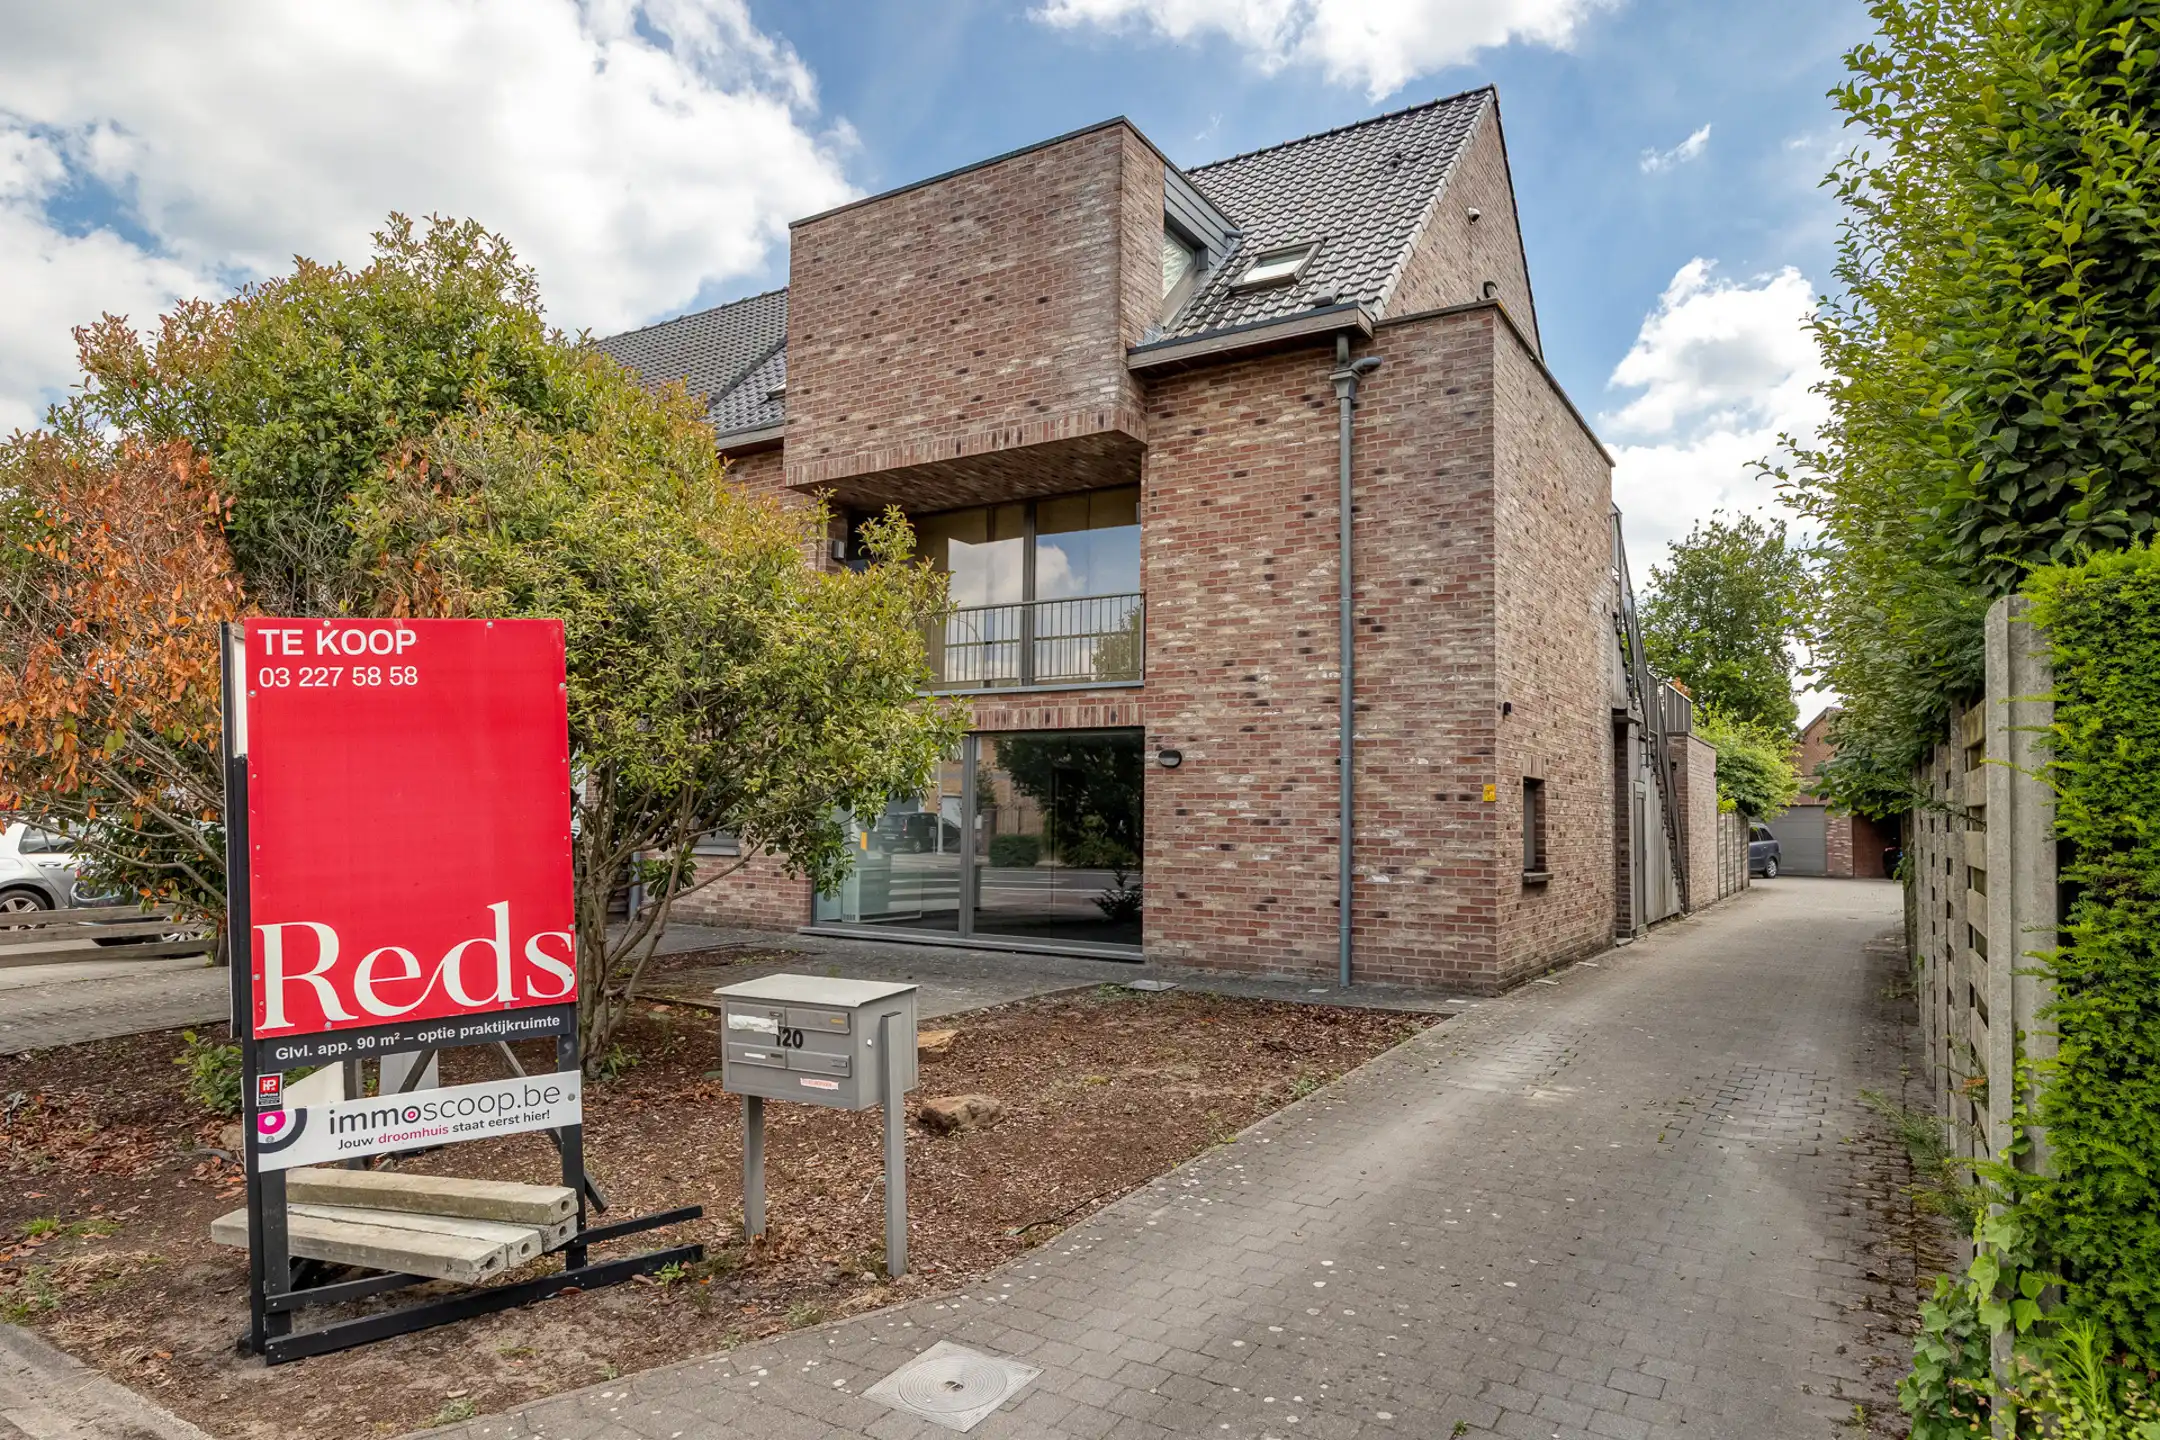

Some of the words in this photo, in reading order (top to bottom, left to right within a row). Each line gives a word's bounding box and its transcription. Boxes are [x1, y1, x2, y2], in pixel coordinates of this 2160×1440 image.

[258, 629, 304, 656] TE
[316, 629, 417, 656] KOOP
[258, 667, 290, 688] 03
[298, 667, 342, 688] 227
[352, 666, 381, 687] 58
[389, 666, 418, 686] 58
[253, 900, 576, 1031] Reds
[275, 1044, 313, 1060] Glvl.
[317, 1042, 352, 1056] app.
[357, 1036, 375, 1050] 90
[380, 1032, 400, 1046] m²
[417, 1027, 456, 1043] optie
[459, 1015, 560, 1039] praktijkruimte
[776, 1025, 803, 1049] 120
[329, 1084, 560, 1135] immoscoop.be
[338, 1137, 374, 1150] Jouw
[378, 1125, 449, 1144] droomhuis
[452, 1119, 485, 1133] staat
[488, 1114, 520, 1127] eerst
[523, 1109, 550, 1122] hier!
